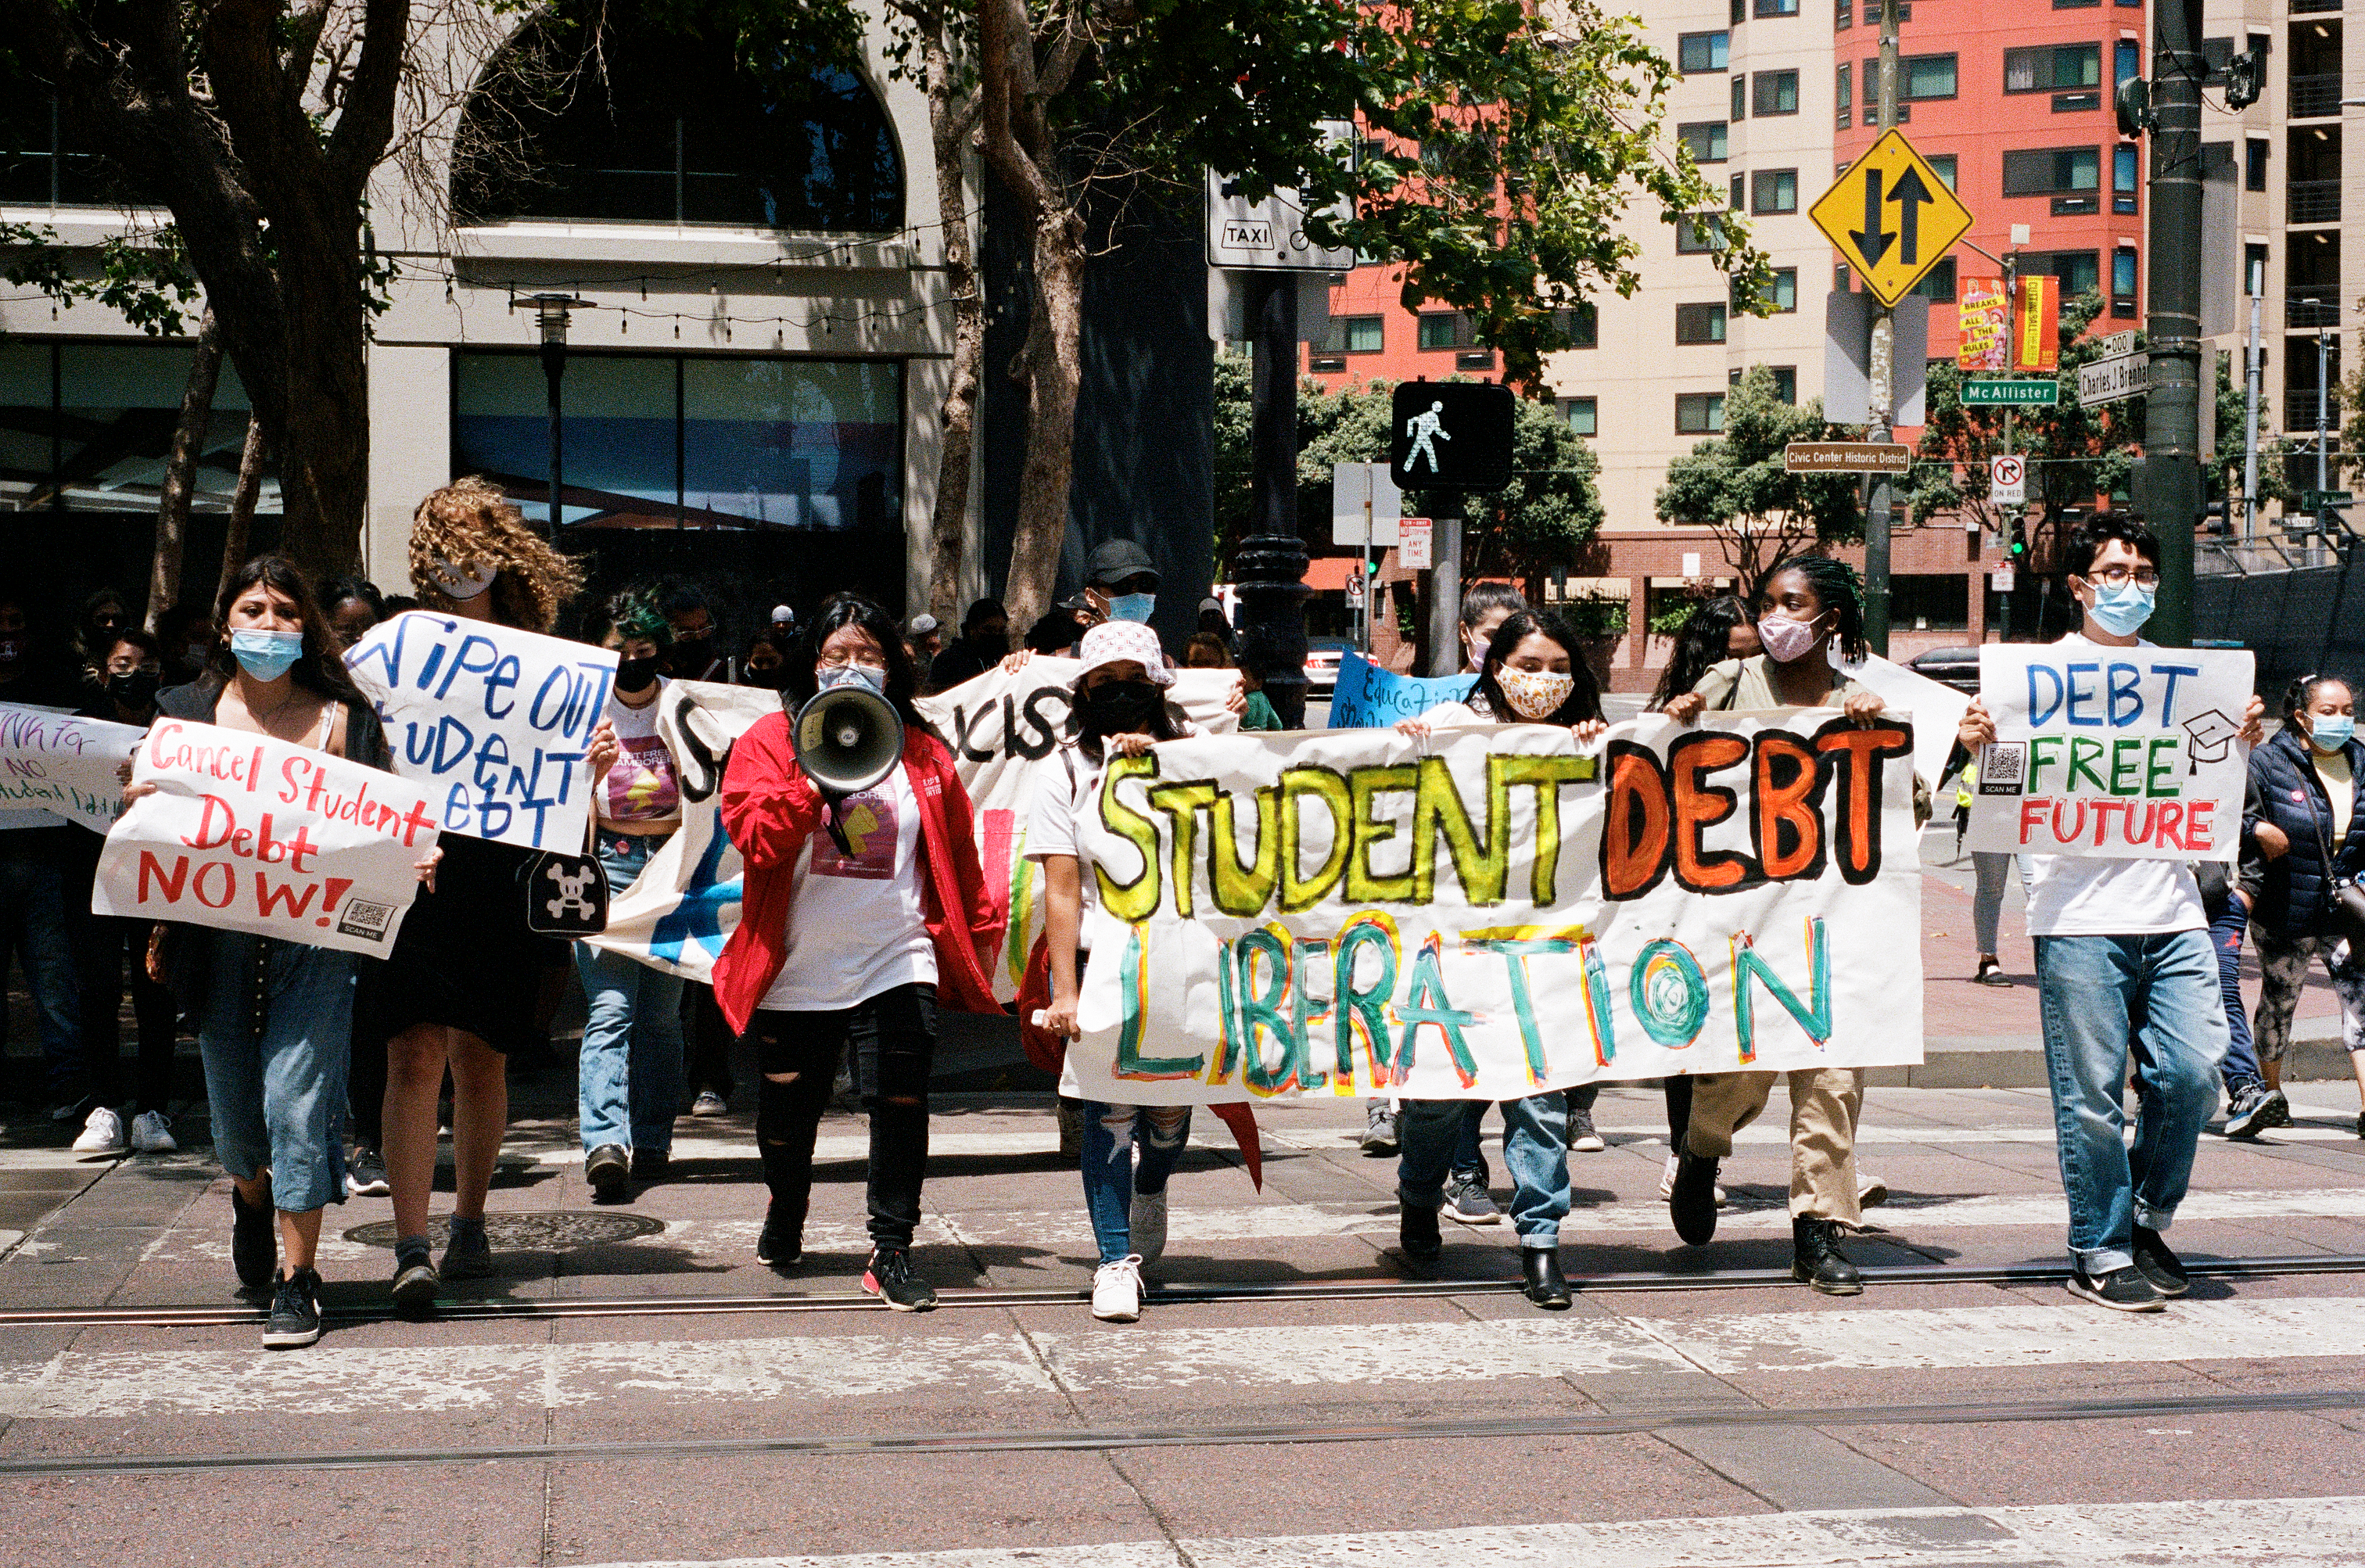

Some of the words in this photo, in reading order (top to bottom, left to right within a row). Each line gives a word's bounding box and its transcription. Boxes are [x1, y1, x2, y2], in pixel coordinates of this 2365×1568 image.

[1227, 228, 1268, 243] TAXI
[1965, 299, 1998, 310] BREAKS
[1965, 317, 1982, 326] ALL
[1977, 327, 1994, 336] THE
[1962, 342, 1990, 353] RULES
[2082, 372, 2111, 396] Charles
[2112, 368, 2117, 389] J
[2119, 361, 2148, 388] Brenha
[1968, 386, 2049, 399] McAllister
[1789, 451, 1811, 463] Civic
[1813, 451, 1843, 463] Center
[1845, 451, 1876, 464] Historic
[1879, 453, 1907, 465] District
[1400, 526, 1409, 536] NO
[1408, 549, 1423, 558] TIME
[2025, 657, 2204, 729] DEBT
[529, 662, 617, 750] OUT
[614, 755, 673, 767] AMBOREE
[619, 751, 642, 760] EBT
[5, 756, 47, 778] NO
[2028, 732, 2184, 798] FREE
[151, 723, 265, 792] Cancel
[278, 755, 438, 847] Student
[1984, 785, 2005, 794] SCAN
[2006, 785, 2017, 794] ME
[847, 791, 895, 801] BOREE
[1094, 749, 1601, 924] STUDENT
[1599, 716, 1915, 901] DEBT
[2019, 795, 2220, 852] FUTURE
[180, 793, 319, 874] Debt
[138, 849, 353, 928] NOW!
[344, 924, 365, 937] SCAN
[366, 930, 379, 939] ME
[1112, 910, 1834, 1098] LIBERATION
